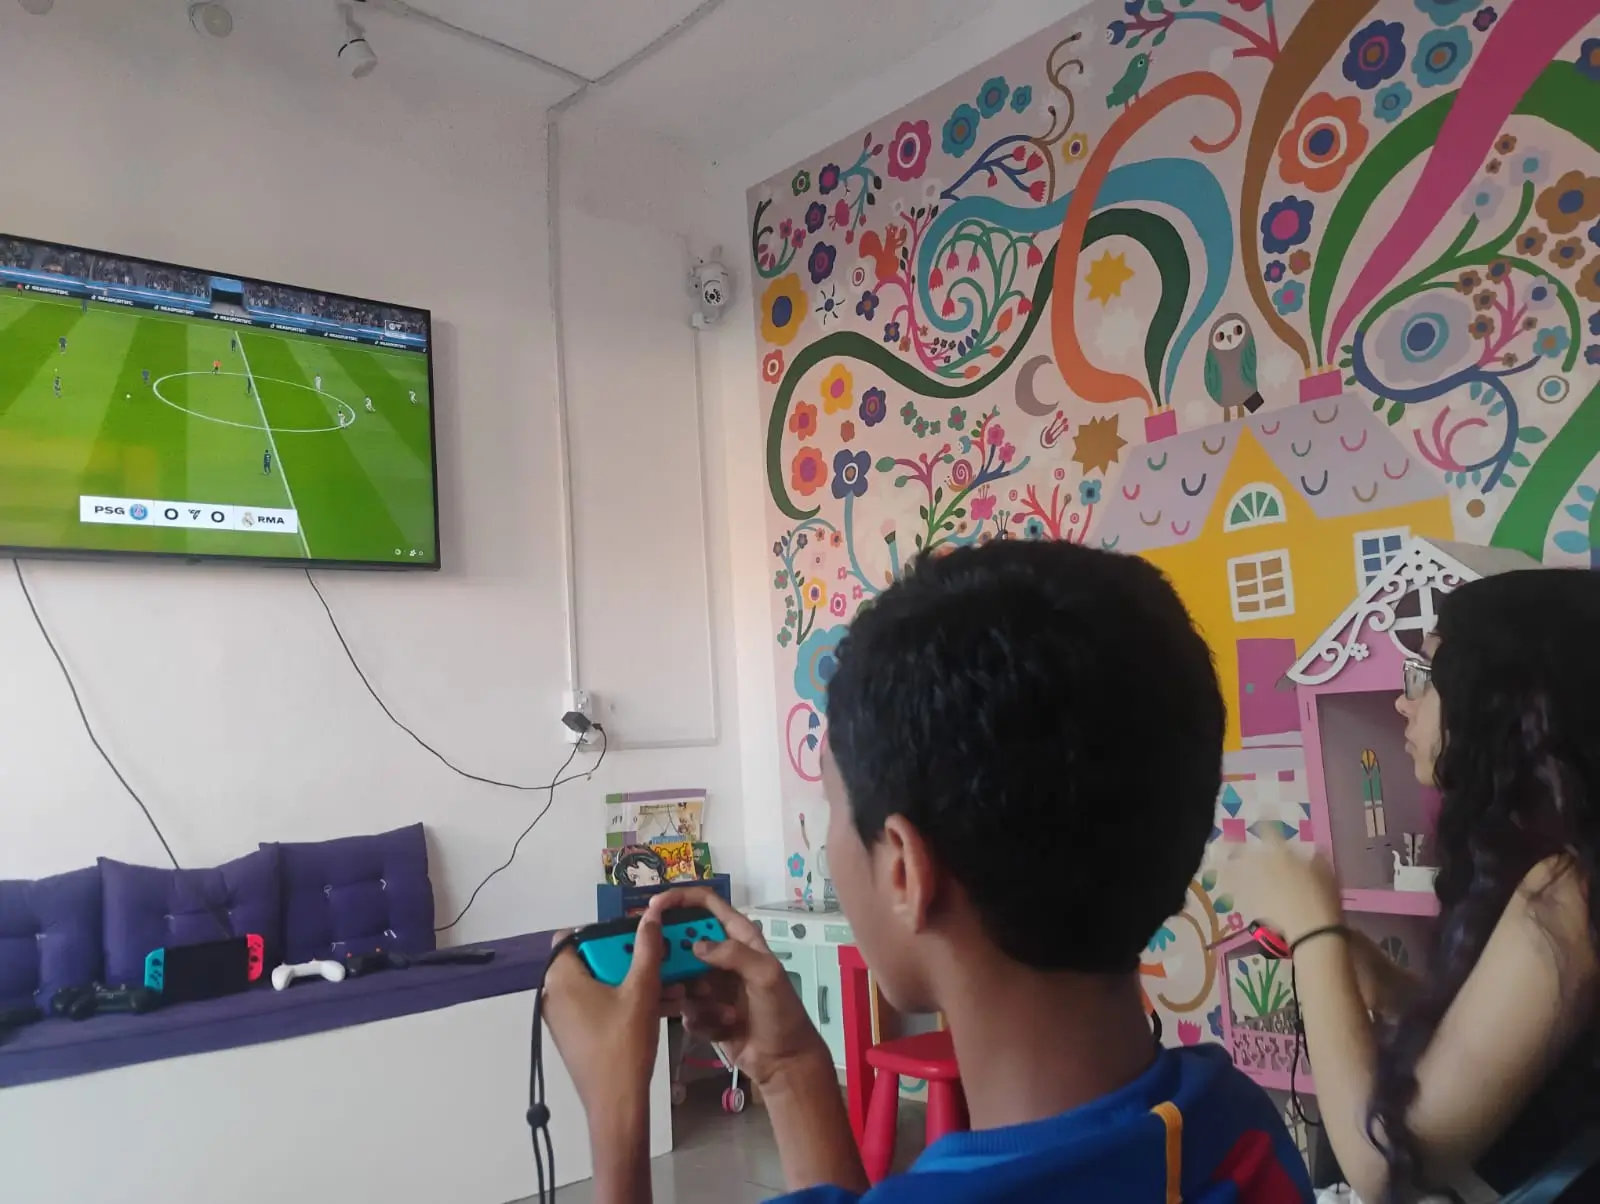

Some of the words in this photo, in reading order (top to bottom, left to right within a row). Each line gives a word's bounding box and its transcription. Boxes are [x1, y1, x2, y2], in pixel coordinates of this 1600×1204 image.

[94, 505, 125, 516] PSG
[164, 507, 179, 521] 0
[210, 510, 225, 523] 0
[257, 515, 285, 525] RMA
